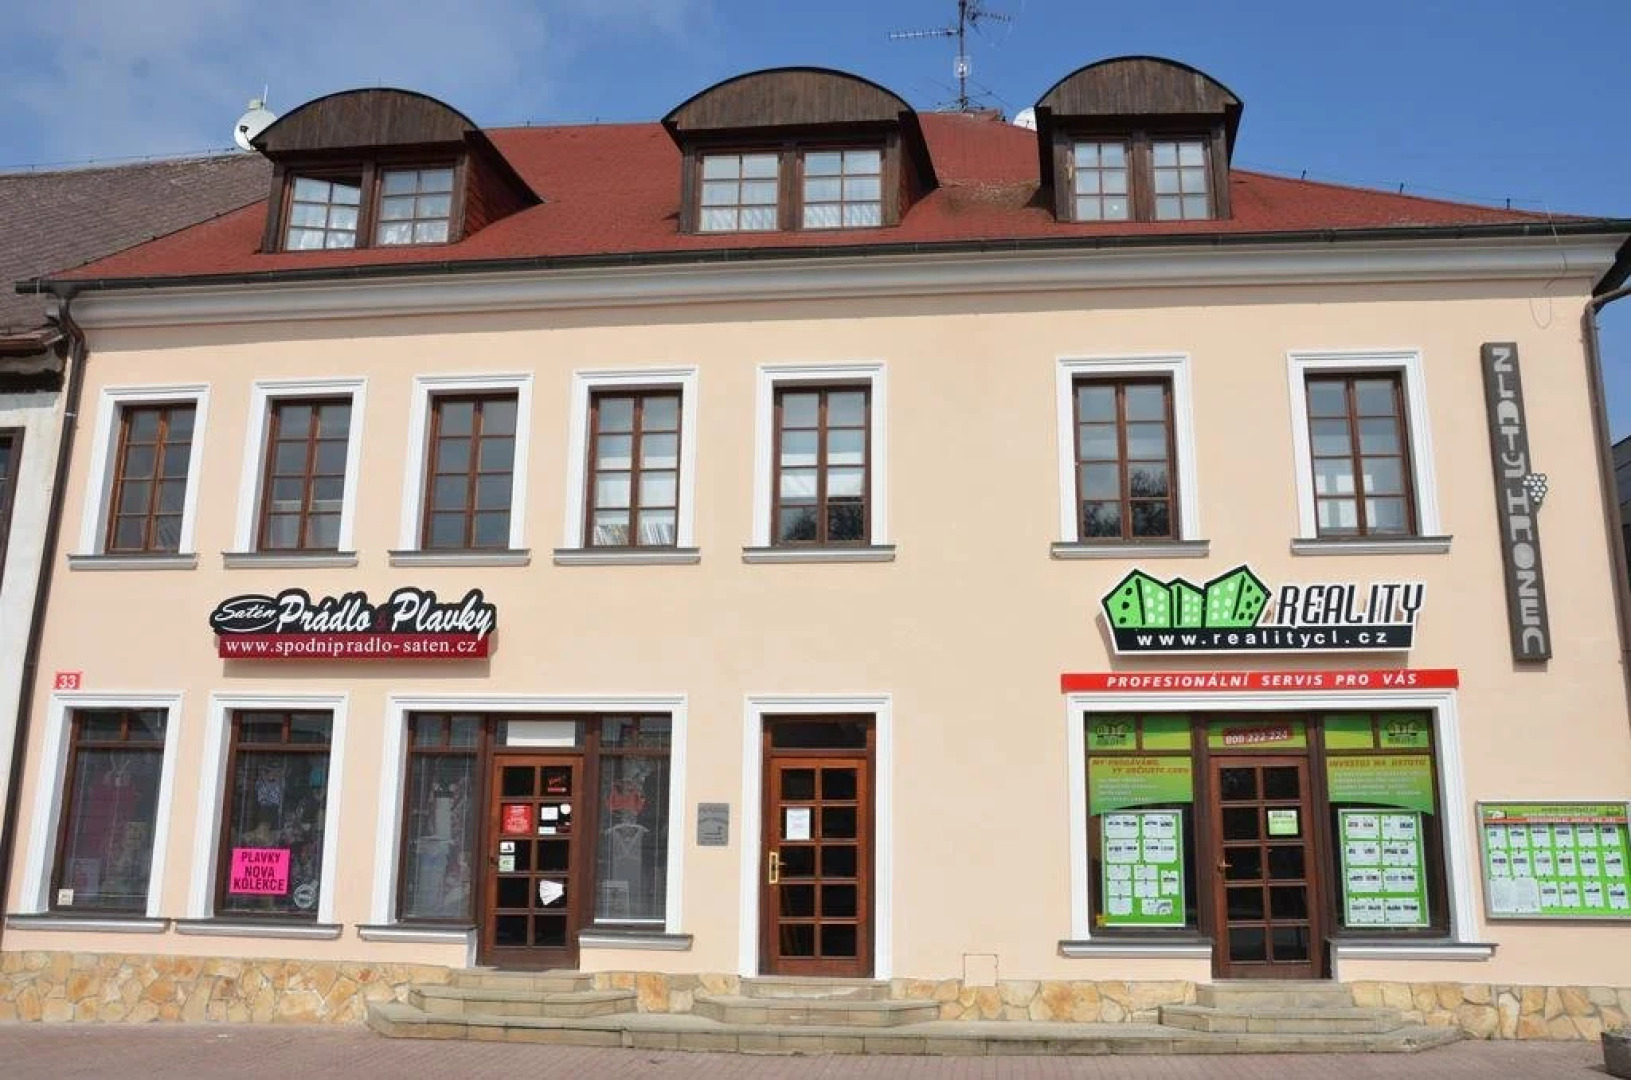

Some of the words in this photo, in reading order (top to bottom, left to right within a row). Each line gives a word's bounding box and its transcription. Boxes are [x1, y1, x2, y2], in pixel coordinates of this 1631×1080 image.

[215, 604, 277, 621] Satén
[1277, 584, 1424, 625] REALITY
[276, 592, 371, 633] Prádlo
[392, 592, 492, 640] Plavky
[226, 638, 476, 656] www.spodnipradlo-saten.cz
[1137, 630, 1387, 648] www.realitycl.cz
[59, 674, 76, 688] 33
[1107, 672, 1250, 687] PROFESIONÁLNÍ
[1261, 673, 1323, 686] SERVIS
[1335, 673, 1369, 686] PRO
[1382, 671, 1418, 685] VÁS
[242, 852, 280, 862] PLAVKY
[245, 867, 275, 879] NOVA
[234, 878, 285, 891] KOLEKCE
